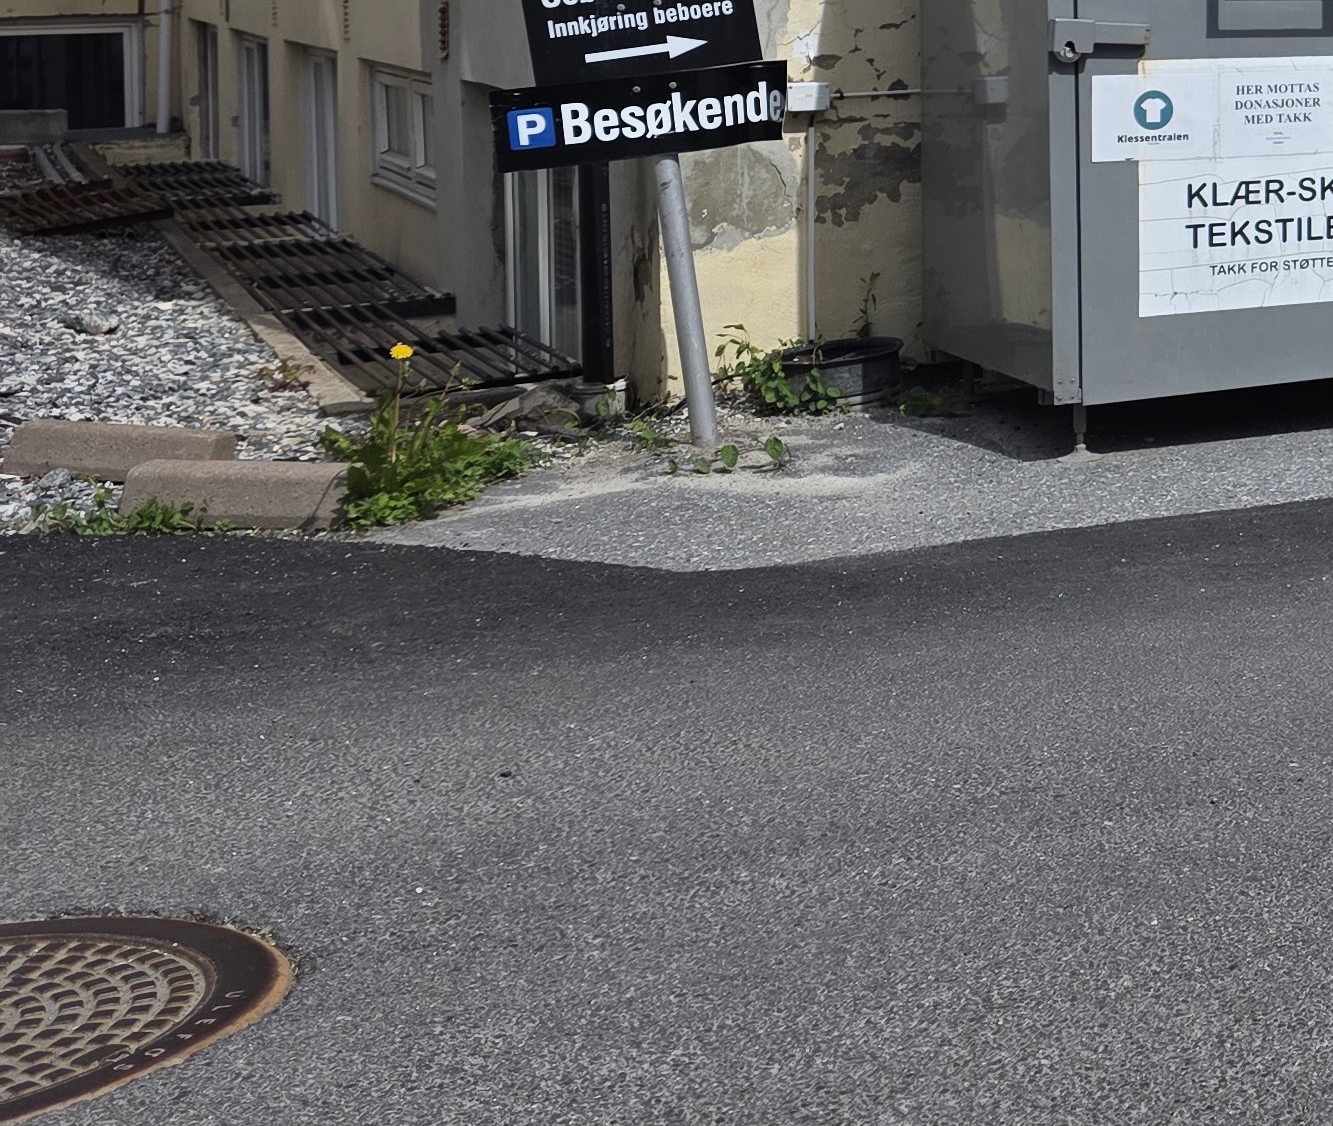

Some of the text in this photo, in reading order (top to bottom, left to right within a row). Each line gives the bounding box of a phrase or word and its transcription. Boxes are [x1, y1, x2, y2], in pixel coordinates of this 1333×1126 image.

[548, 8, 648, 38] Innkjøring
[1236, 82, 1320, 96] HER MOTTAS
[1234, 97, 1321, 111] DONASJONER
[517, 81, 785, 146] P Besøkende
[1244, 111, 1312, 125] MED TAKK
[1117, 132, 1189, 144] Klessentralen
[1209, 262, 1247, 277] TAKK
[1251, 259, 1279, 273] FOR
